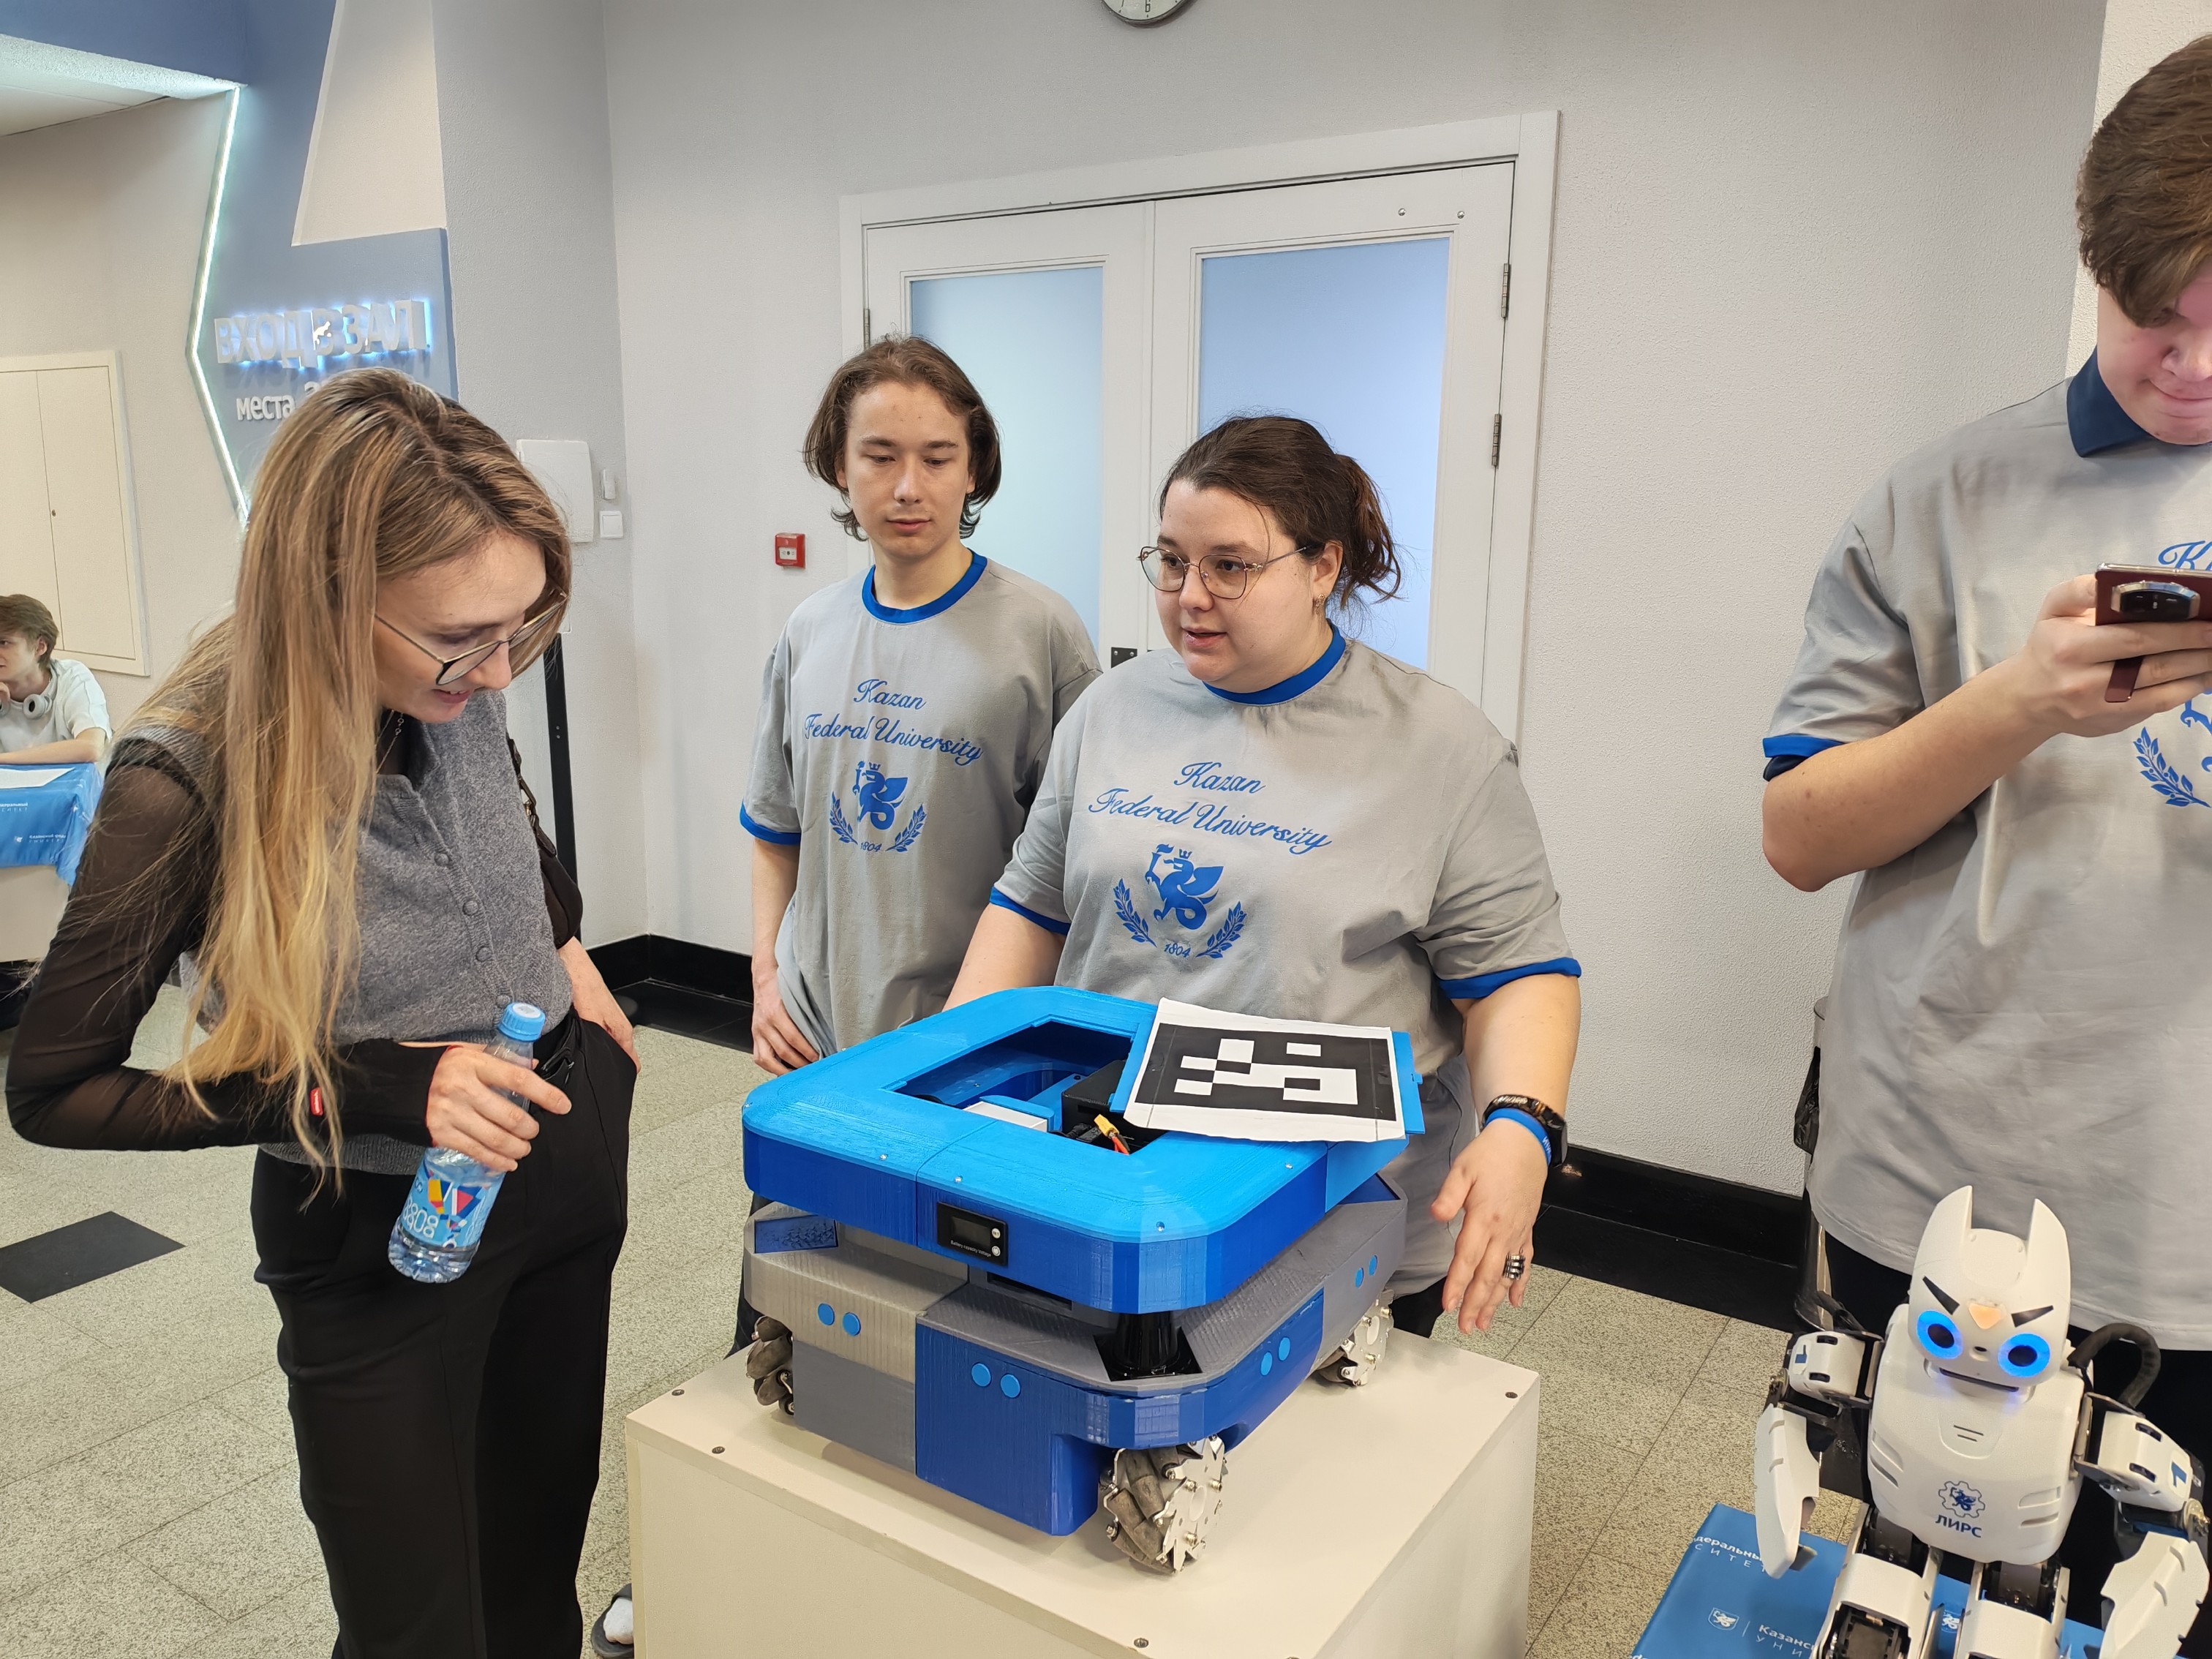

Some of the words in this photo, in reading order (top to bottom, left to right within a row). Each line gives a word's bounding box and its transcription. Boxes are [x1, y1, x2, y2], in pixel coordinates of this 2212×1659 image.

[214, 310, 317, 369] ВХОД
[312, 308, 342, 356] В
[342, 299, 426, 355] ЗАЛ
[236, 395, 295, 421] места
[2158, 540, 2212, 571] K
[853, 679, 926, 710] Kazan
[805, 713, 875, 740] Federal
[875, 718, 984, 766] University
[1174, 761, 1265, 794] Kazan
[1088, 788, 1197, 824] Federal
[1193, 805, 1332, 855] University
[860, 841, 882, 851] 1804
[1163, 943, 1192, 958] 1804
[1936, 1514, 1982, 1538] ЛИРС
[1758, 1625, 1816, 1651] Казанс
